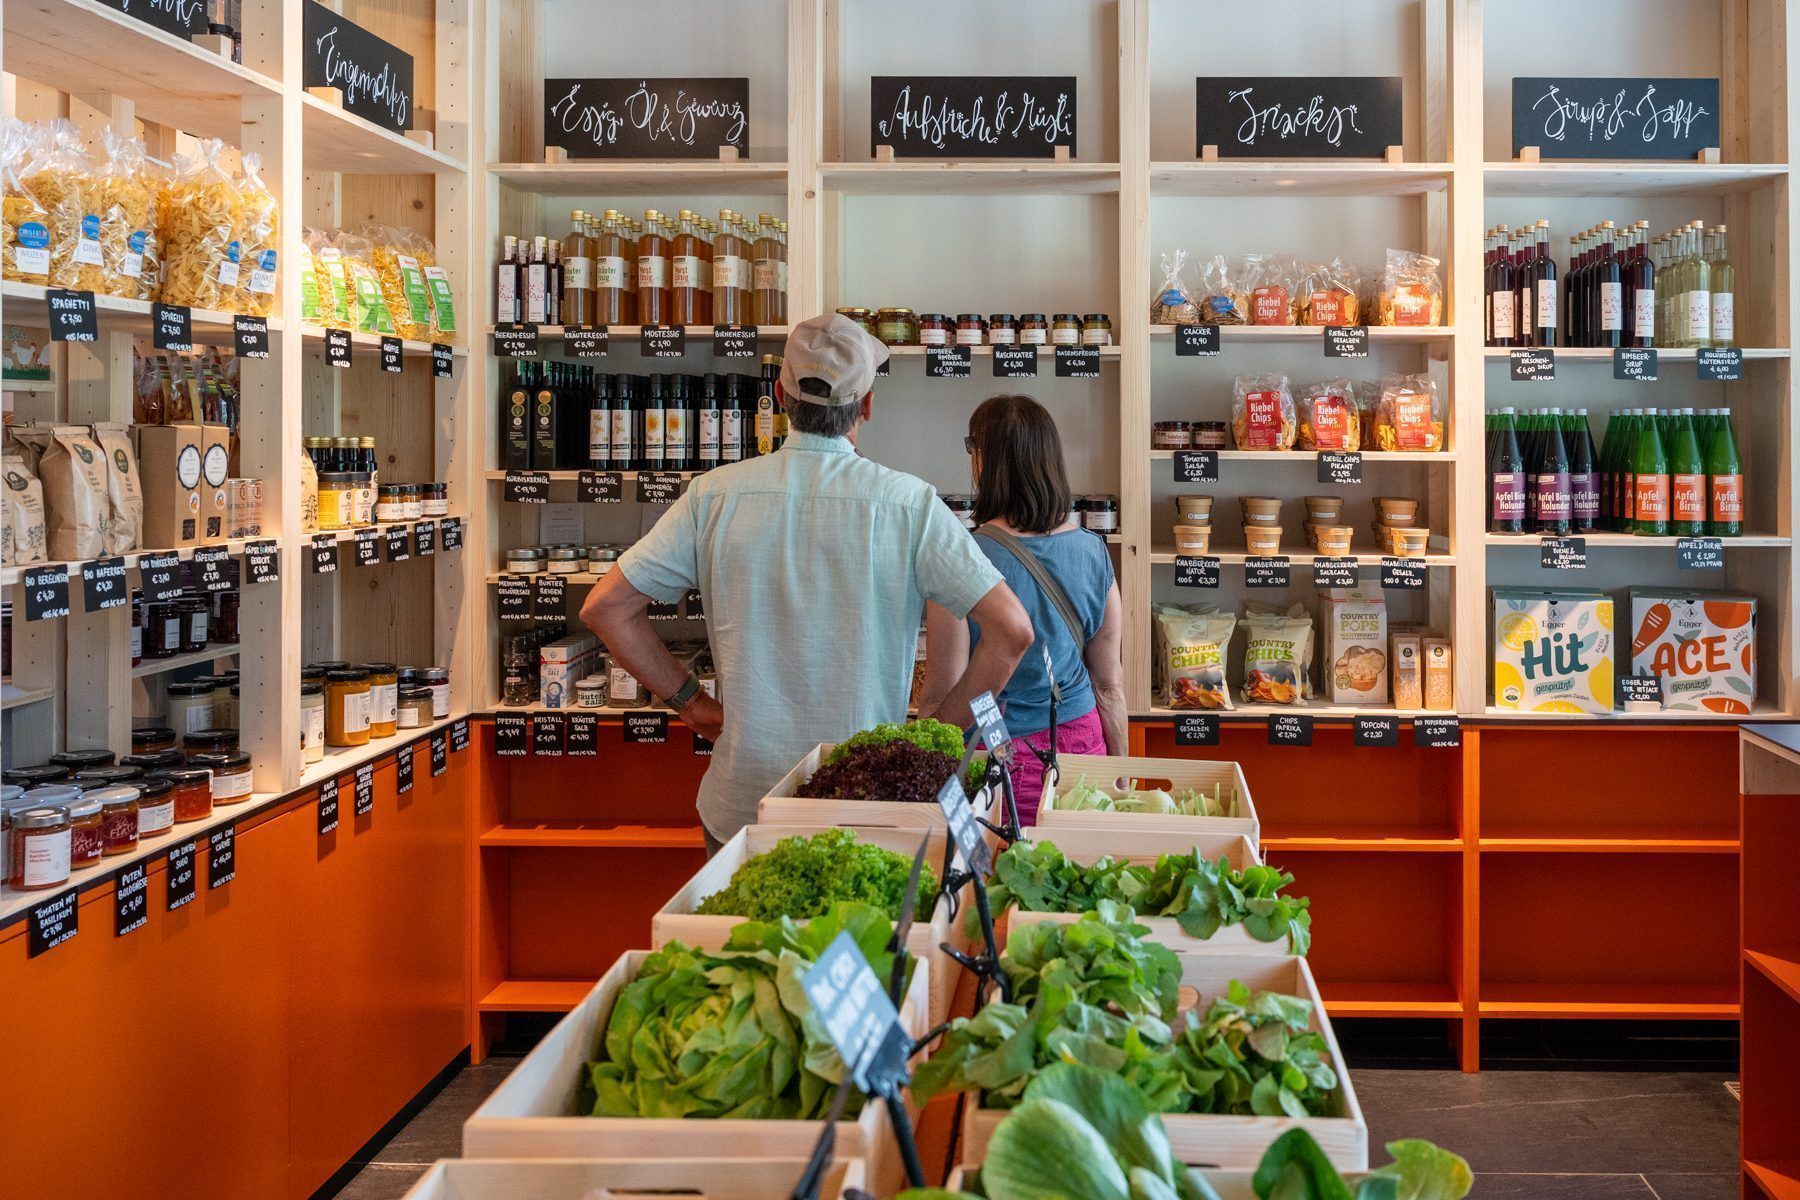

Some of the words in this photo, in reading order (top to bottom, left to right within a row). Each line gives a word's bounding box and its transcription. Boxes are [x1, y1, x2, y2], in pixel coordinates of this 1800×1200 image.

[660, 103, 676, 142] &
[52, 298, 90, 311] SPAGHETTI
[1257, 296, 1281, 307] Riebel
[1315, 301, 1339, 312] Riebel
[161, 310, 184, 324] SPIRELLI
[1258, 306, 1278, 319] Chips
[1317, 311, 1337, 323] Chips
[564, 331, 609, 339] KRÄUTERESSIG
[644, 330, 680, 338] MOSTESSIG
[714, 331, 756, 339] BIRNENESSIG
[1183, 328, 1212, 336] CRACKER
[1328, 329, 1349, 337] RIEBEL
[995, 351, 1034, 359] NASCHKATZE
[1250, 402, 1274, 413] Riebel
[1317, 404, 1340, 415] Riebel
[1399, 404, 1424, 414] Riebel
[1251, 412, 1272, 424] Chips
[1317, 414, 1338, 426] Chips
[1400, 414, 1421, 425] Chips
[1322, 455, 1343, 463] RIEBEL
[1495, 491, 1514, 502] Apfel
[1538, 492, 1555, 503] Apfel
[1555, 492, 1571, 502] Birne
[1637, 490, 1659, 503] Apfel
[1675, 490, 1697, 503] Apfel
[1715, 491, 1737, 504] Apfel
[1541, 501, 1570, 511] Holunder
[1641, 501, 1663, 512] Birne
[1679, 501, 1701, 512] Birne
[1719, 501, 1740, 513] Birne
[1340, 620, 1380, 632] POPS
[1542, 620, 1566, 630] Egger
[1678, 619, 1703, 629] Egger
[1170, 642, 1221, 655] COUNTRY
[1170, 651, 1220, 669] CHIPS
[1247, 648, 1293, 662] CHIPS
[1521, 632, 1589, 680] Hit
[1650, 635, 1731, 678] ACE
[1535, 679, 1573, 695] gespritzt
[1672, 679, 1710, 691] gespritzt
[1185, 718, 1205, 726] CHIPS
[1279, 717, 1298, 725] CHIPS
[1360, 720, 1390, 730] POPCORN
[1179, 725, 1210, 733] GESALZEN
[1275, 724, 1302, 733] PAPRIKA
[121, 865, 143, 887] PUTEN
[117, 876, 148, 901] BOLOGNESE
[35, 898, 65, 920] TOMATEN
[40, 906, 73, 930] BASILIKUM
